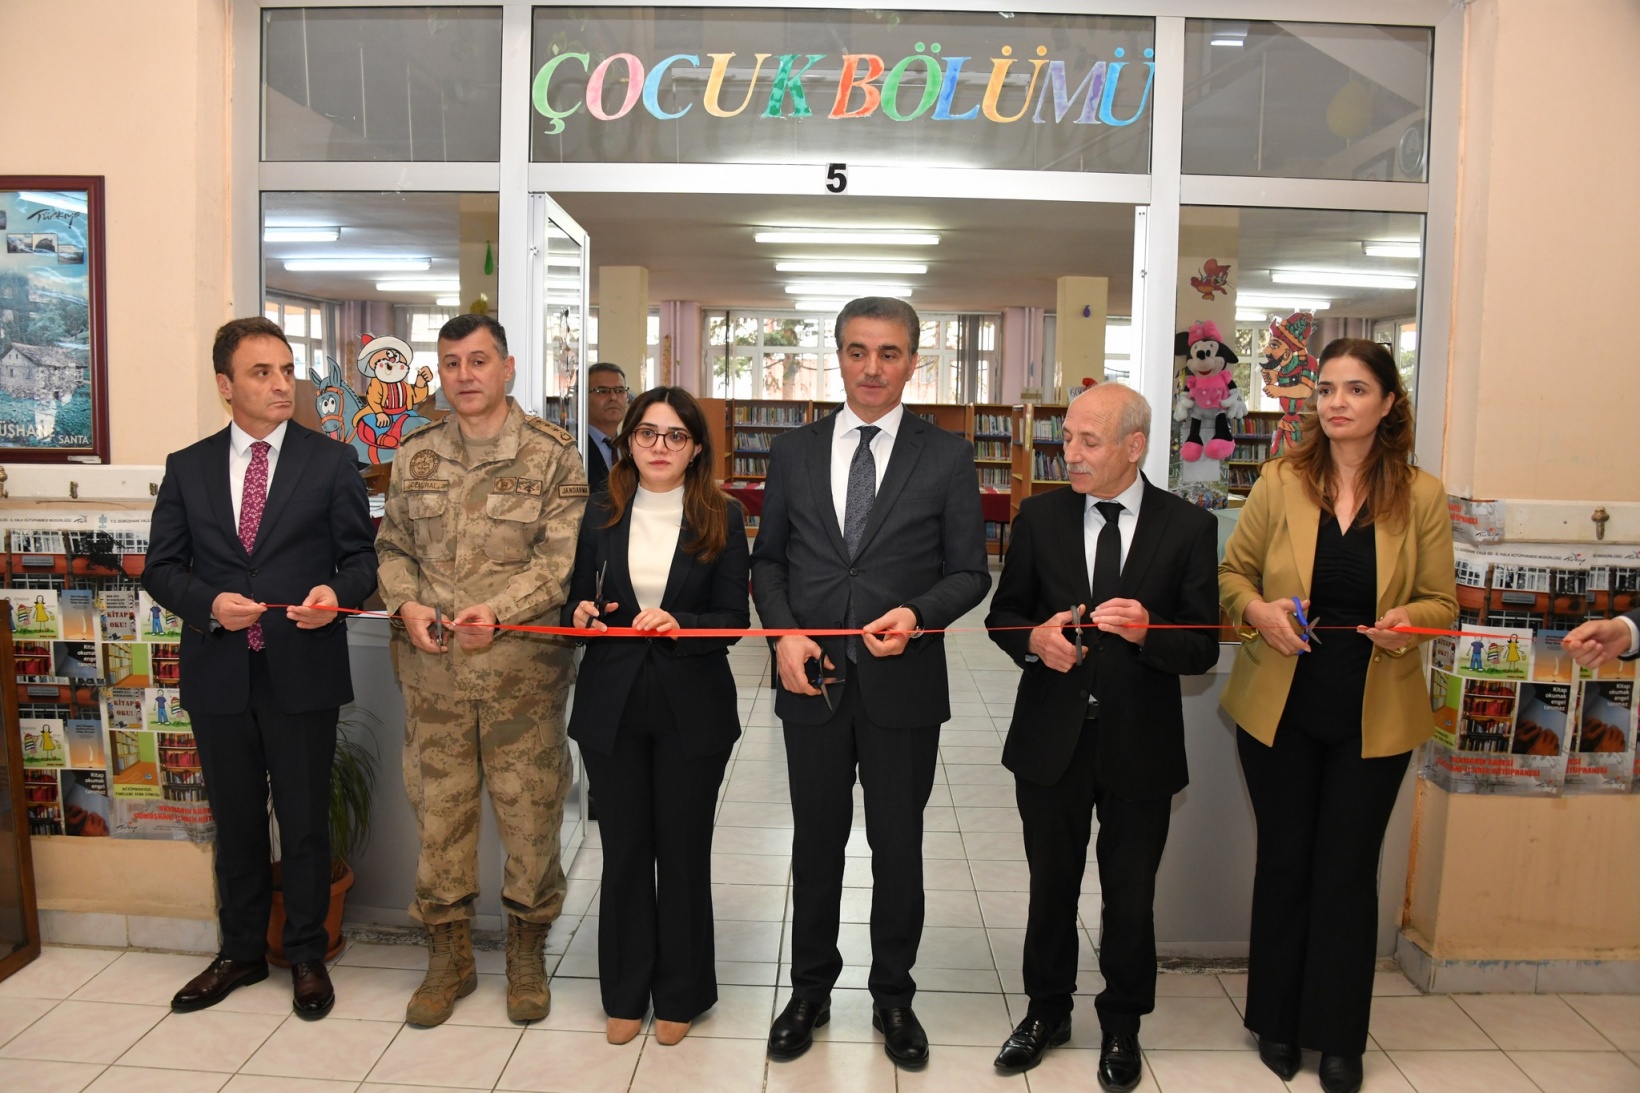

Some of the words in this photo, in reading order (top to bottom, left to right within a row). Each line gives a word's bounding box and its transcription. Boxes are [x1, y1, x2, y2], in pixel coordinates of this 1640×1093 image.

[532, 52, 827, 135] ÇOCUK
[828, 41, 1155, 126] BÖLÜMÜ
[826, 163, 847, 193] 5
[0, 420, 55, 438] ÜŞHANE
[58, 435, 89, 445] SANTA
[106, 610, 129, 618] KİTAP
[113, 699, 135, 707] KİTAP
